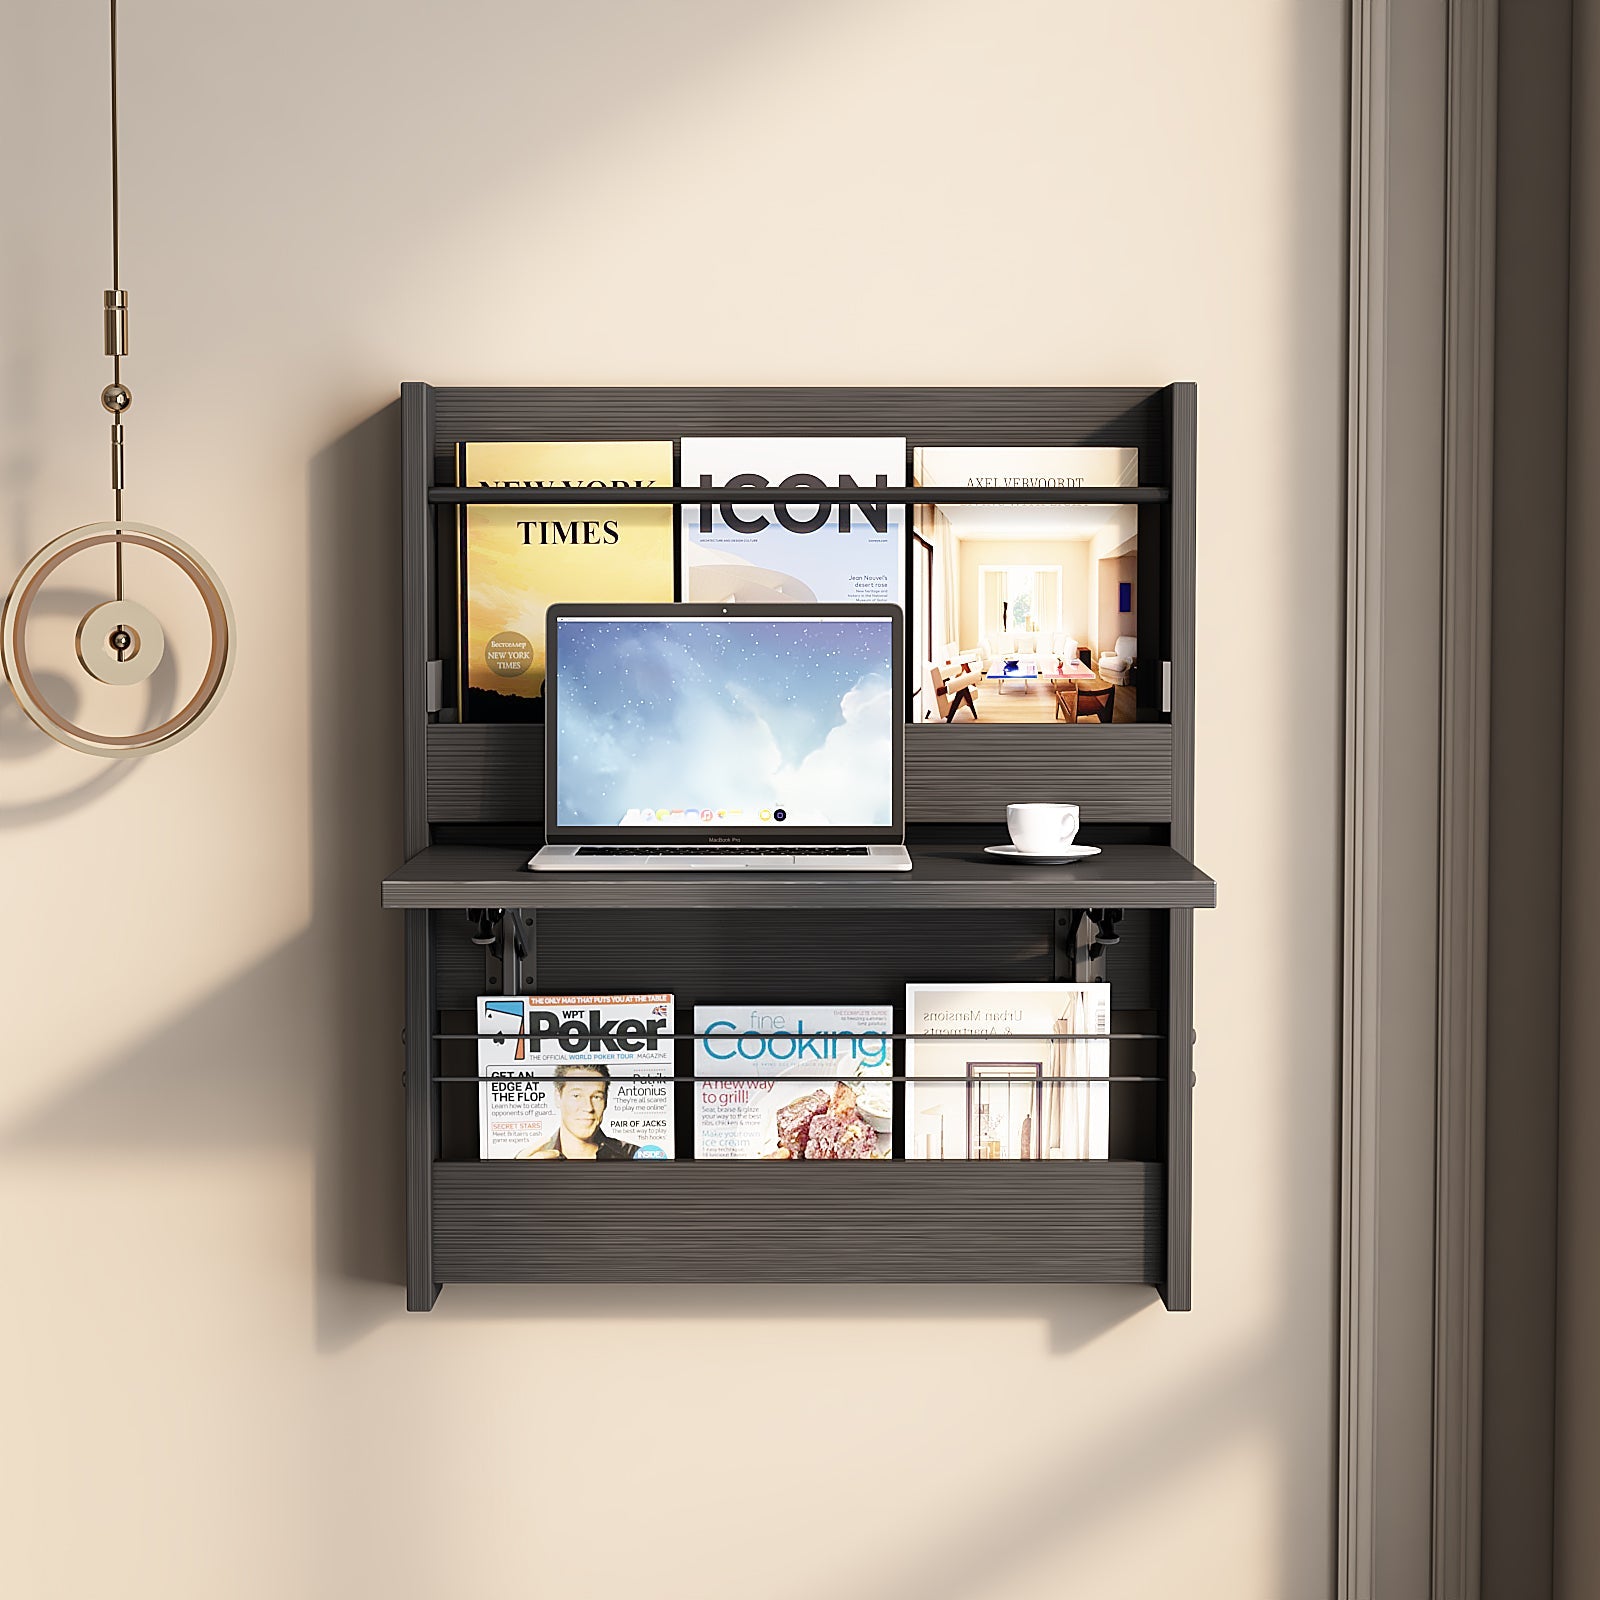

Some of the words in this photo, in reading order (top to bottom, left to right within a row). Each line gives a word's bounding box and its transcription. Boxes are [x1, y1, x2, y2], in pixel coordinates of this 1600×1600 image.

[700, 473, 888, 533] ICON
[516, 520, 619, 545] TIMES
[487, 651, 507, 660] NEW
[507, 651, 530, 660] YORK
[497, 661, 521, 670] TIMES
[562, 1011, 585, 1019] WPT
[751, 1011, 786, 1029] fine
[529, 1010, 667, 1053] Poker
[703, 1020, 887, 1067] Cooking
[492, 1082, 522, 1091] EDGE
[524, 1082, 539, 1091] AT
[617, 1085, 667, 1096] Antonius
[702, 1081, 713, 1089] A
[714, 1081, 746, 1089] new
[745, 1081, 775, 1093] way
[492, 1093, 515, 1101] THE
[517, 1092, 545, 1101] FLOP
[702, 1092, 717, 1103] to
[719, 1090, 749, 1107] grill!
[641, 1119, 667, 1127] JACKS
[702, 1130, 724, 1138] Make
[723, 1131, 743, 1139] your
[702, 1139, 717, 1147] ice
[719, 1139, 751, 1147] cream
